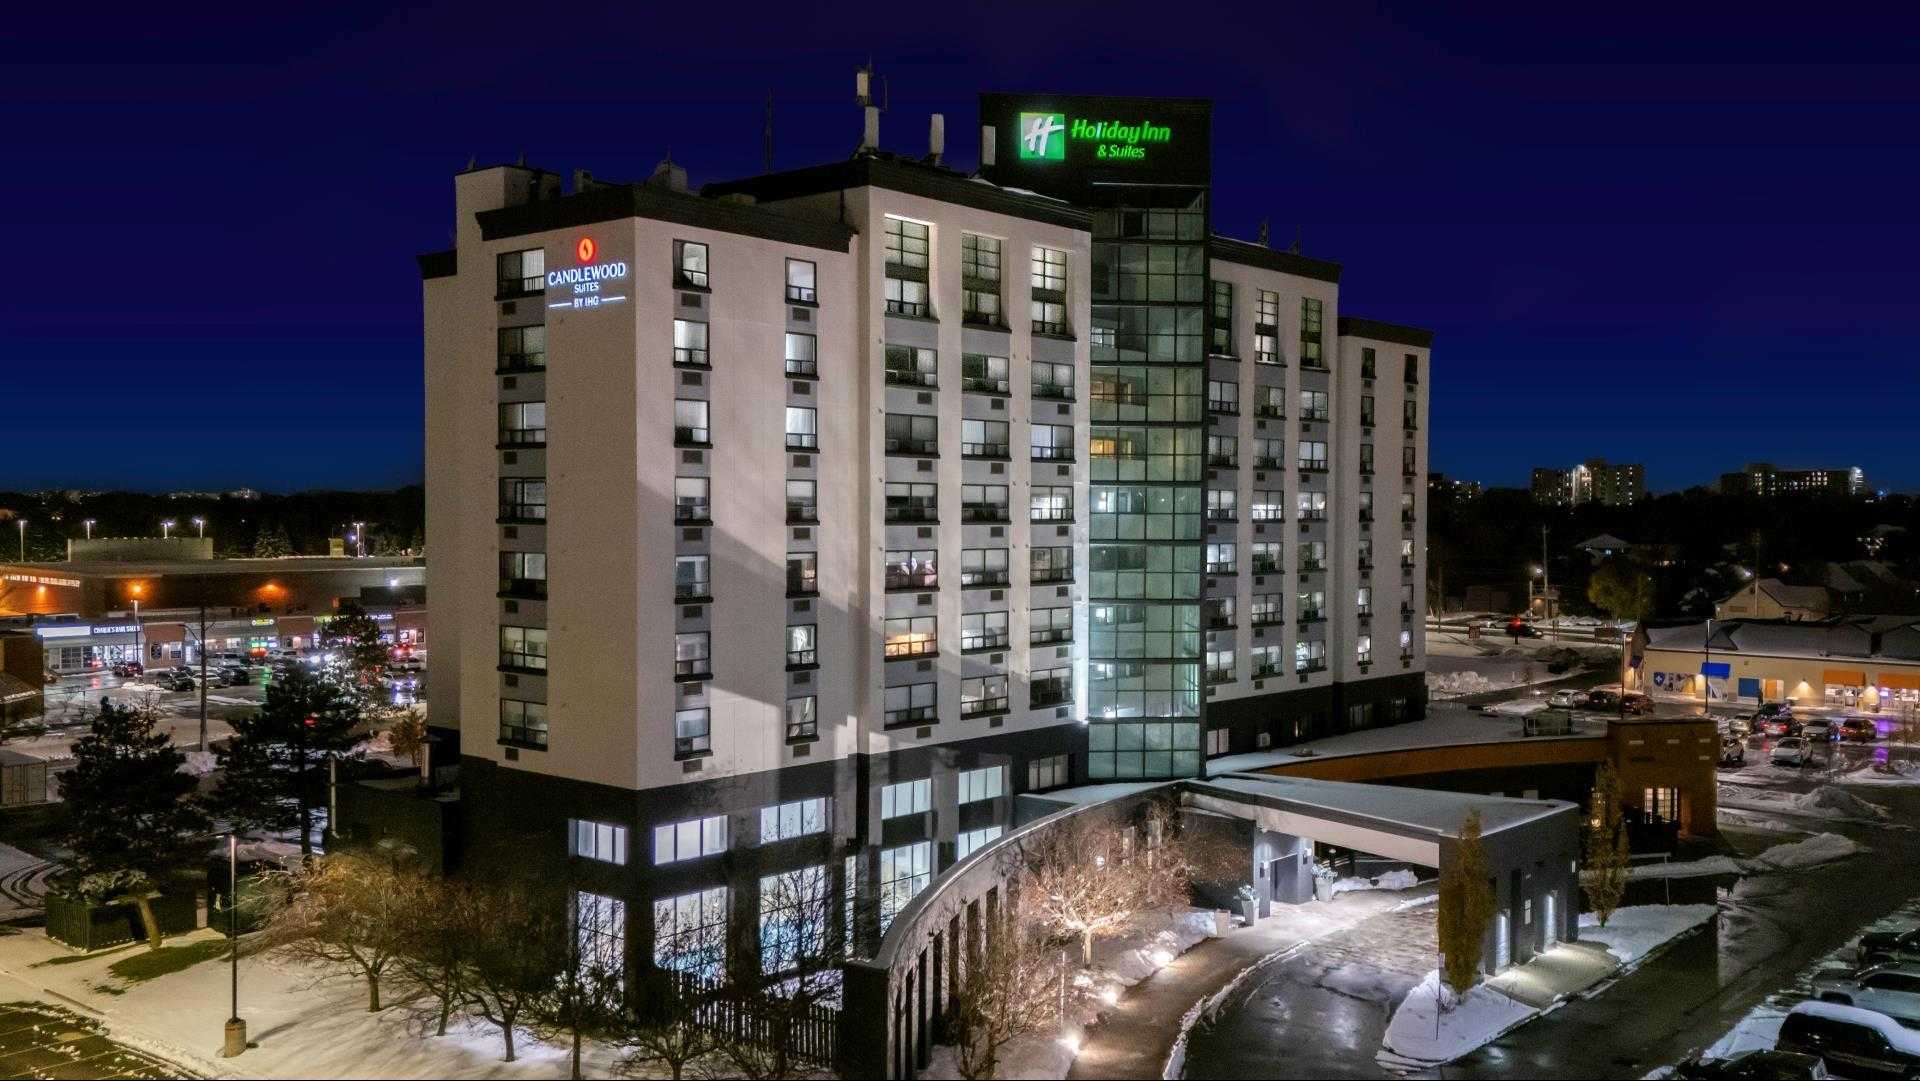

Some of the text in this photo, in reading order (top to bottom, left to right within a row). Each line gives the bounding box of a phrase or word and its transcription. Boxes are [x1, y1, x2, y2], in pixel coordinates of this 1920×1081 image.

[1071, 119, 1171, 144] Holiday Inn
[1097, 144, 1145, 158] & Suites
[548, 262, 626, 286] CANDLEWOOD
[575, 282, 600, 293] SUITES
[574, 296, 599, 308] BY IHG
